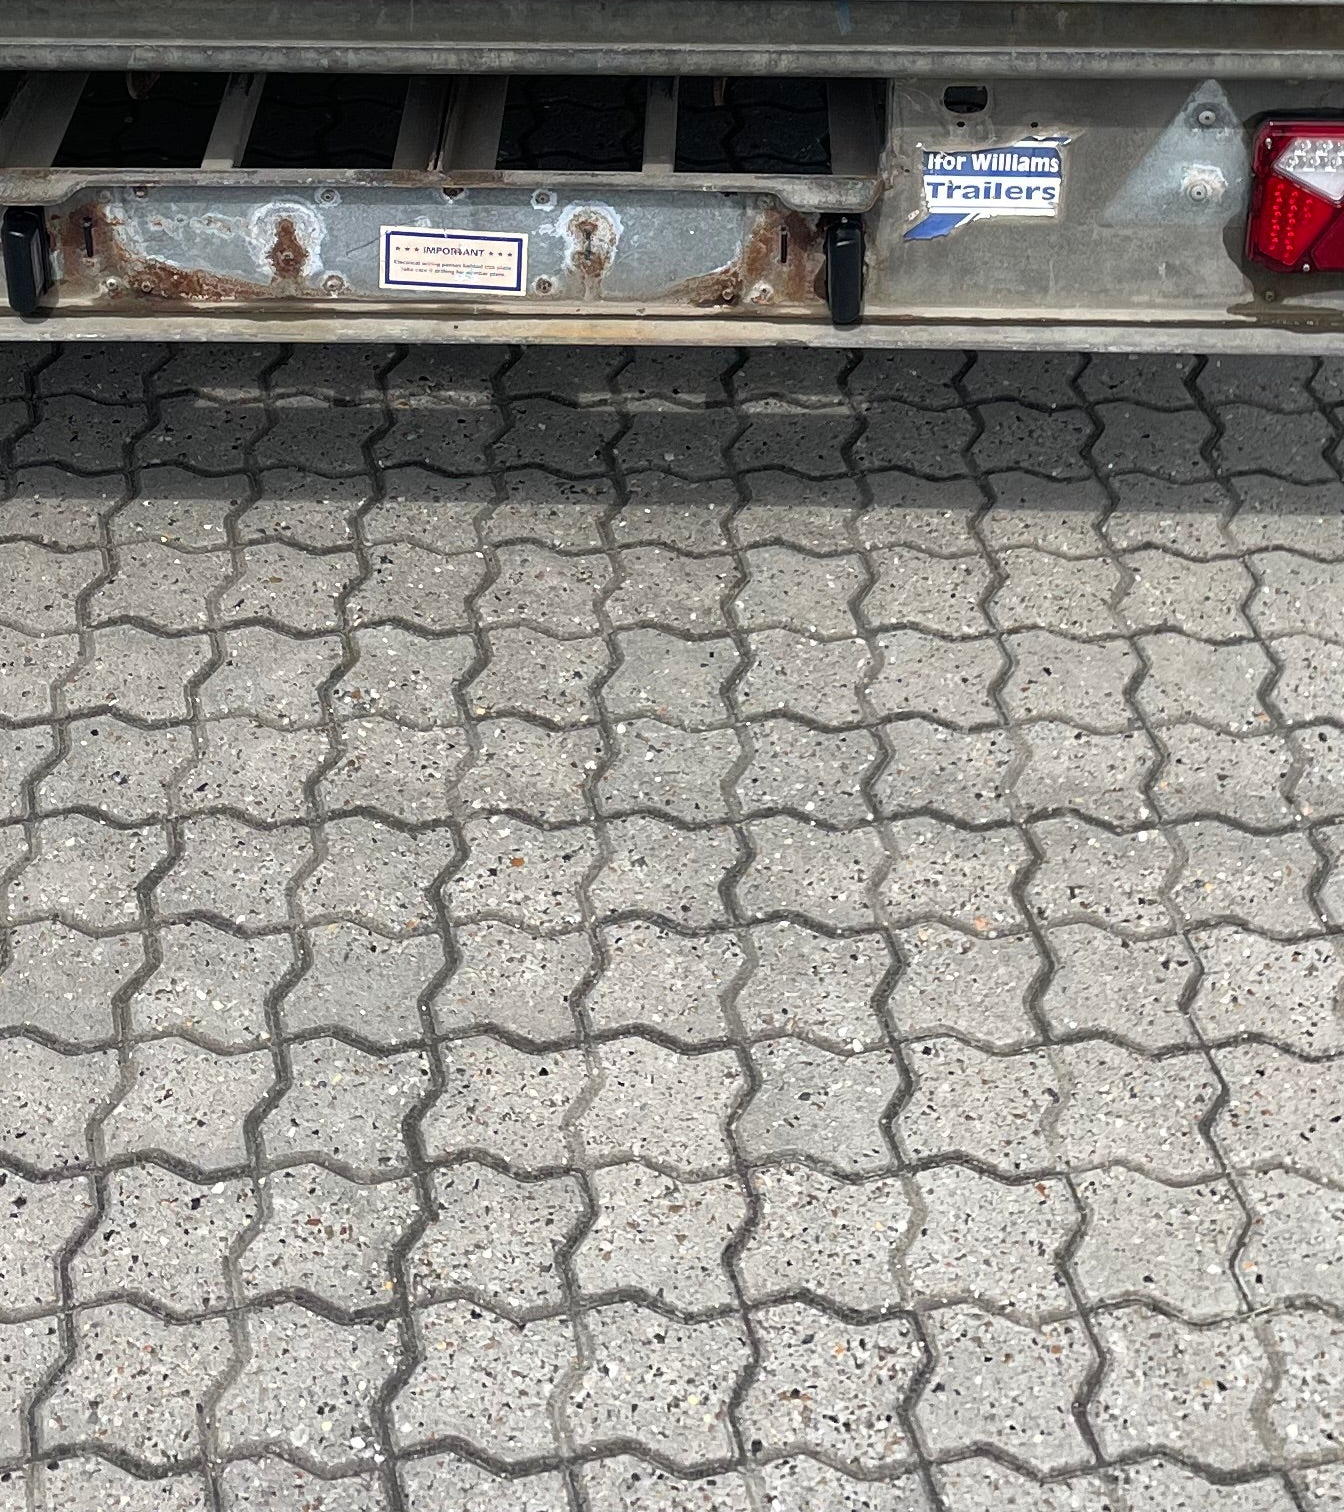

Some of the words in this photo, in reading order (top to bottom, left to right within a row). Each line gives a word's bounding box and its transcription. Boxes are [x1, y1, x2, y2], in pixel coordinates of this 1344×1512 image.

[927, 153, 967, 171] Ifor
[971, 153, 1060, 173] Williams
[926, 181, 1057, 201] Trailers
[423, 246, 486, 257] IMPORTANT
